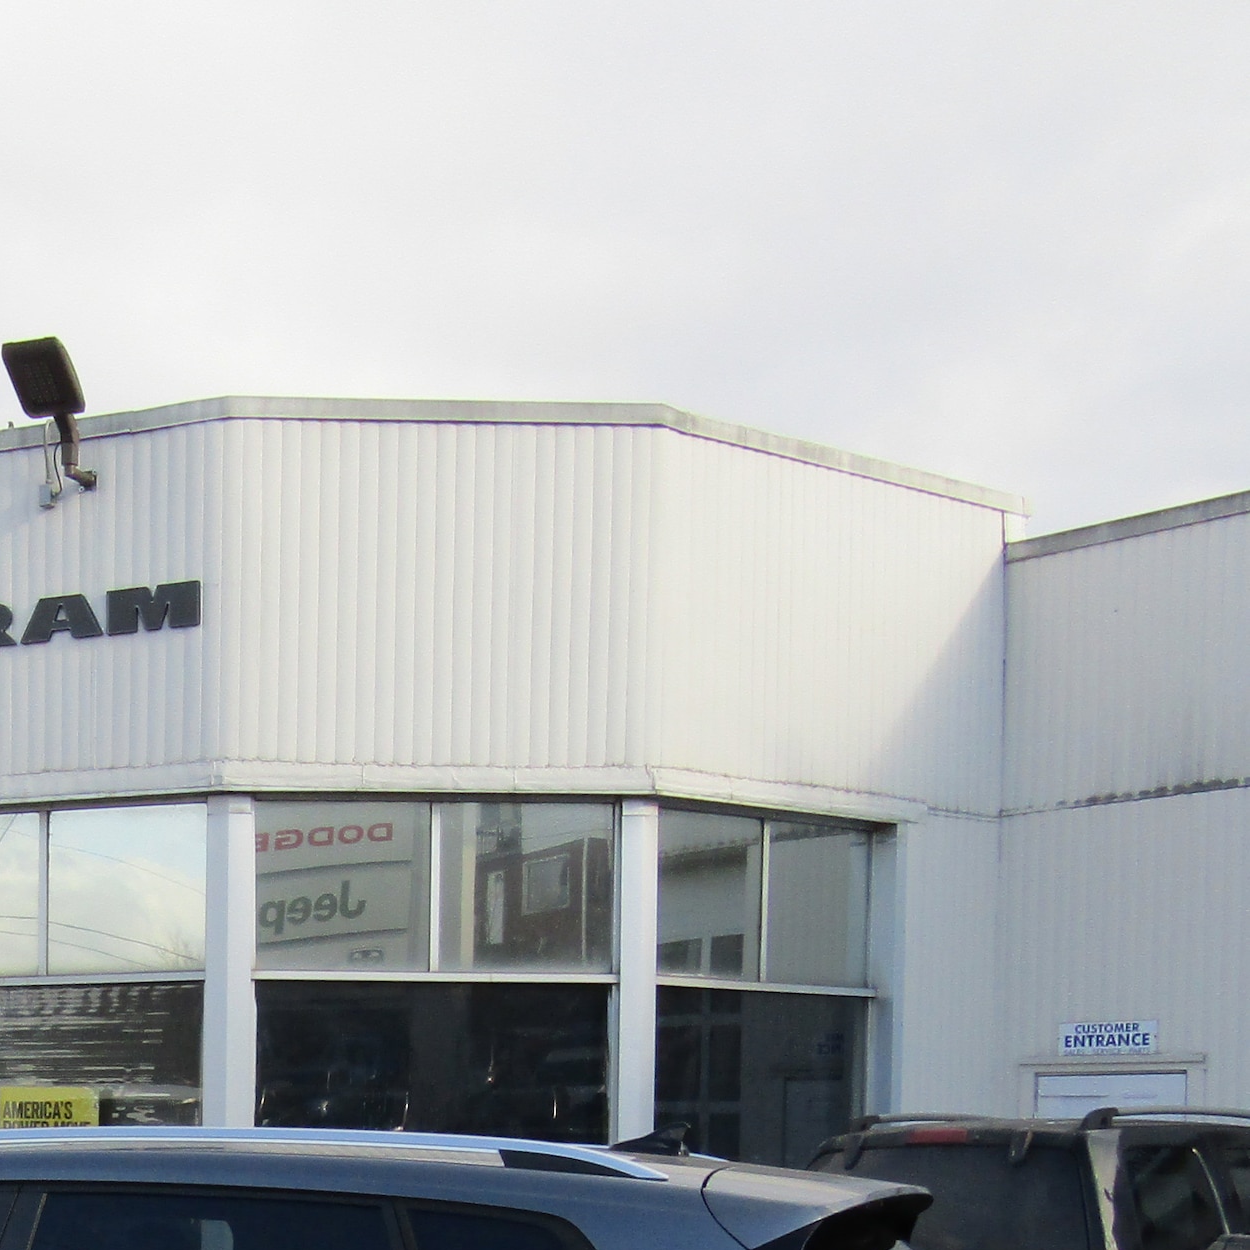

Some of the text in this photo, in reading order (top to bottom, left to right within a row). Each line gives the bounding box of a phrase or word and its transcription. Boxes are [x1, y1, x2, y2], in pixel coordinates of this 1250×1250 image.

[1075, 1023, 1140, 1034] CUSTOMER
[1064, 1033, 1151, 1048] ENTRANCE
[3, 1101, 73, 1119] AMERICA'S
